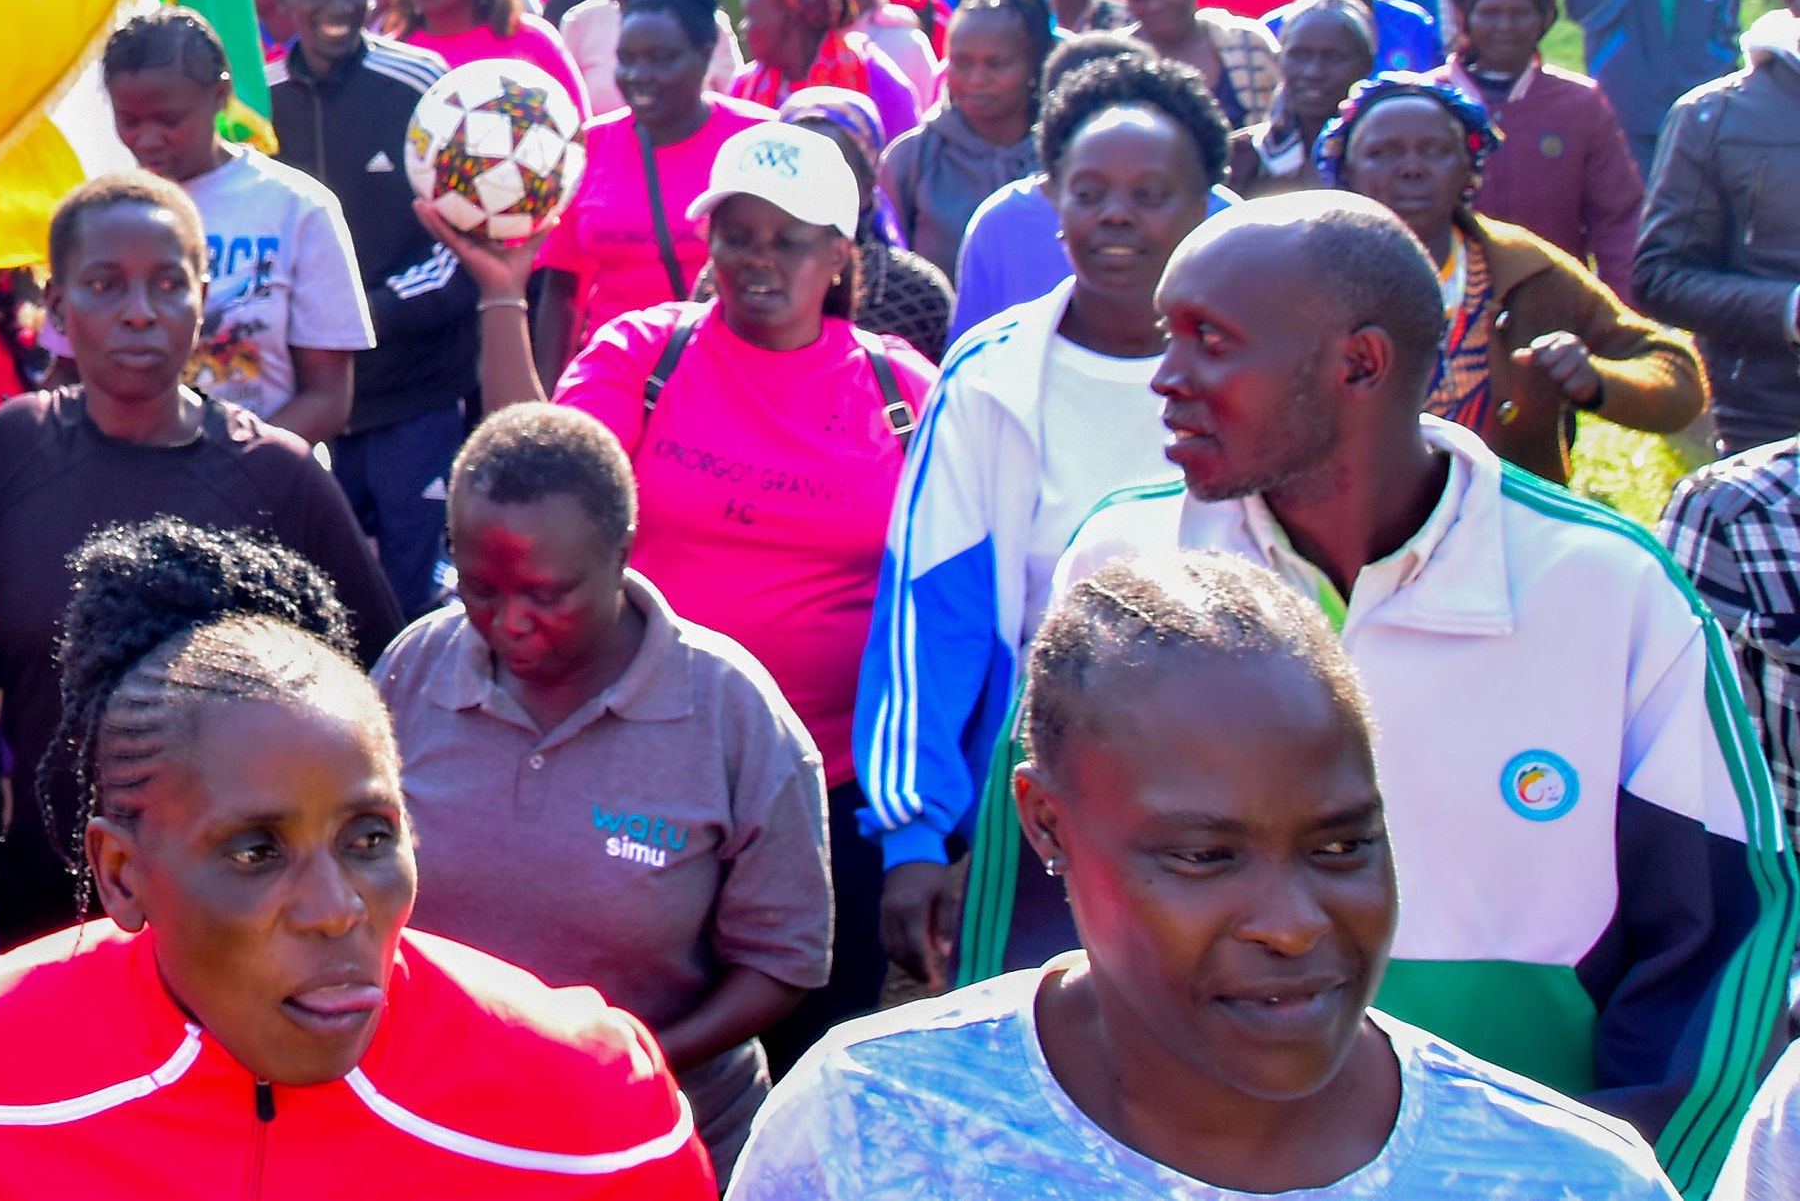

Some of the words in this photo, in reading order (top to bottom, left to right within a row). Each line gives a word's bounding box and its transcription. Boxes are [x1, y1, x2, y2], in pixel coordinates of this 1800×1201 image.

[206, 235, 280, 298] RCE
[592, 803, 688, 851] watu
[605, 834, 666, 868] simu
